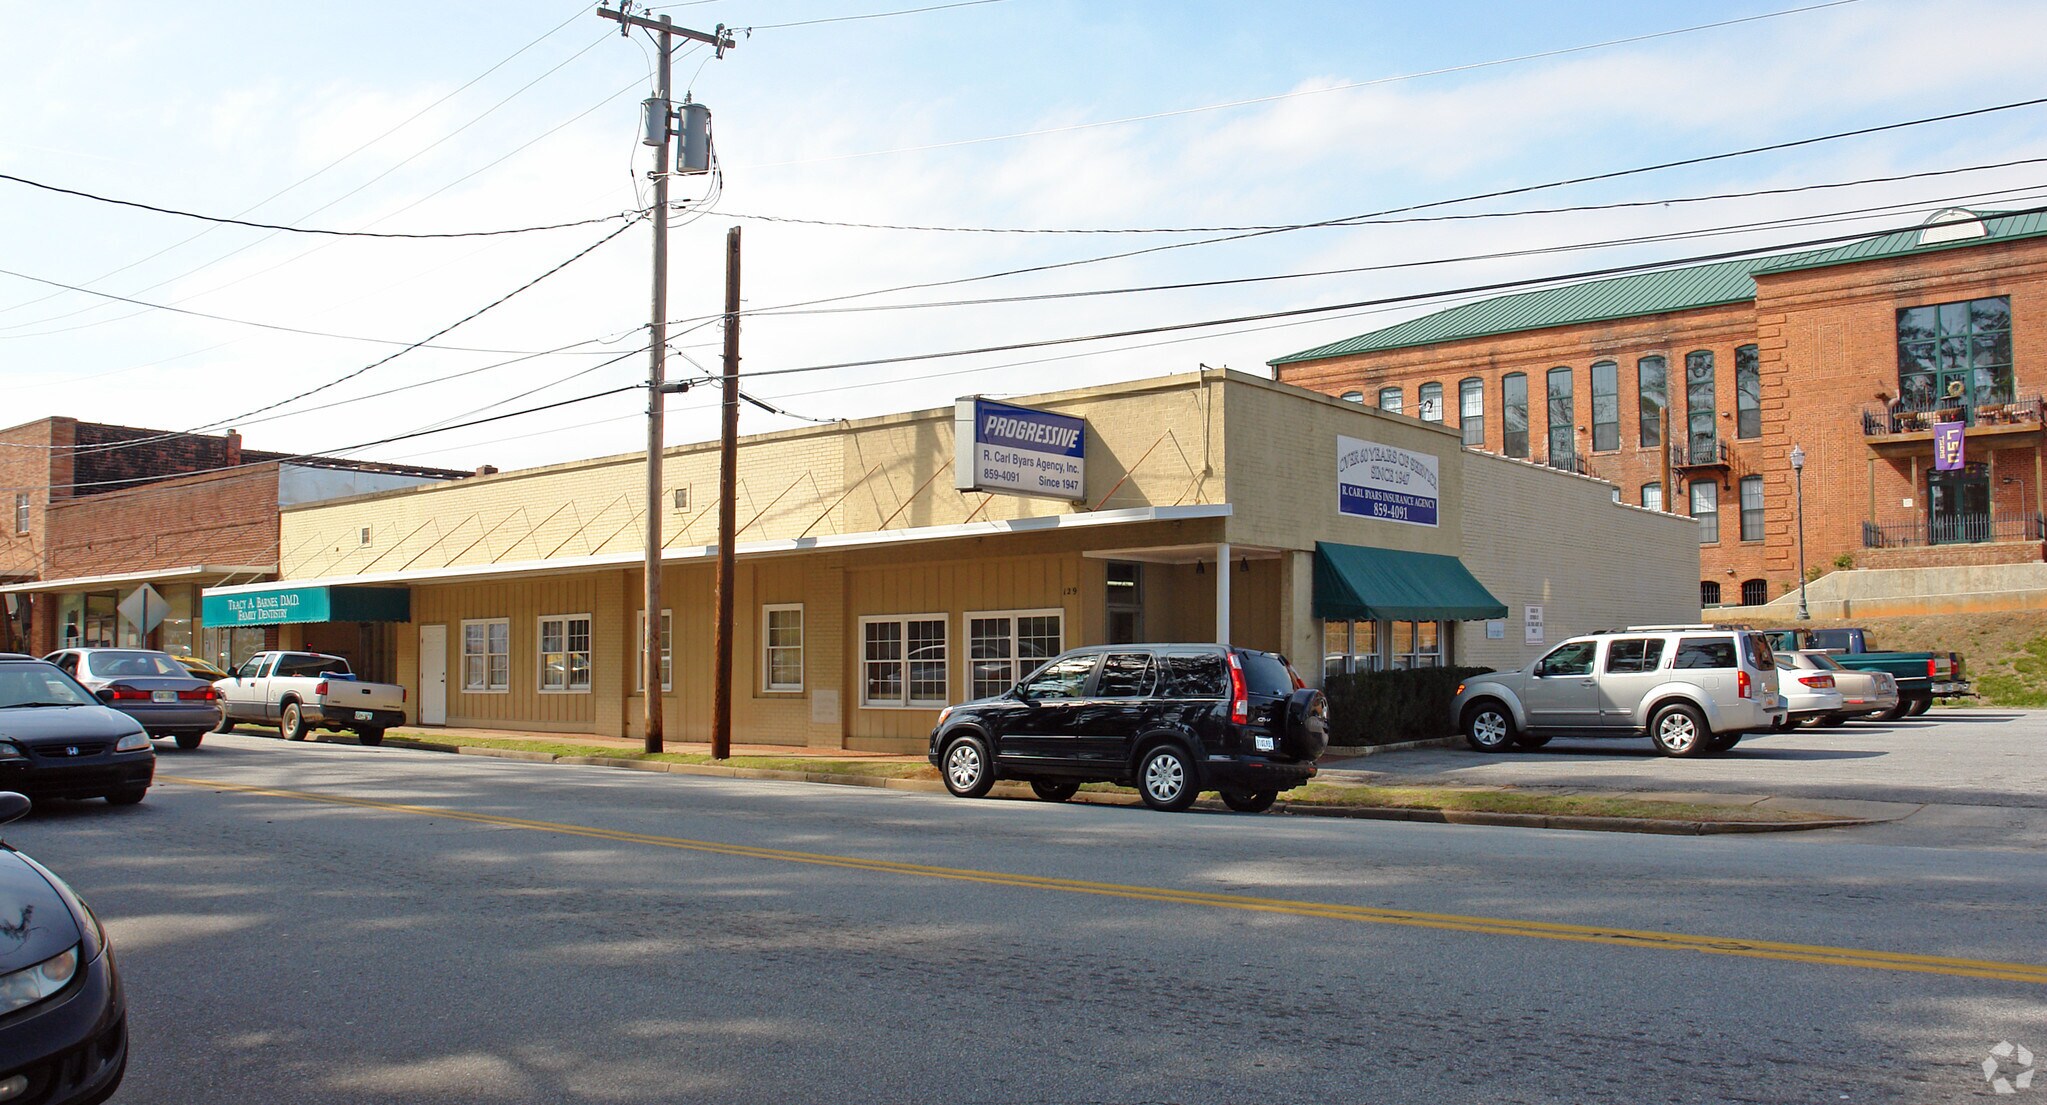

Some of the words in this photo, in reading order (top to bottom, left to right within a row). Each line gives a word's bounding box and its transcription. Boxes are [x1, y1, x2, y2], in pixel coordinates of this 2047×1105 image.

[984, 415, 1080, 449] PROGRESSIVE
[1946, 429, 1960, 464] LSU
[983, 449, 992, 461] R.
[994, 451, 1011, 464] Carl
[1012, 454, 1034, 470] Byars
[1036, 458, 1065, 474] Agency,
[1066, 461, 1079, 474] Inc.
[1339, 451, 1360, 473] OVER
[1368, 447, 1397, 464] YEARS
[1398, 452, 1410, 468] OF
[1410, 457, 1438, 490] SERVICE
[984, 468, 1020, 483] 859-4091
[1038, 475, 1060, 488] Since
[1062, 479, 1079, 490] 1947
[1370, 465, 1394, 483] SINCE
[1395, 470, 1411, 485] 1947
[1342, 486, 1348, 495] R.
[1349, 486, 1364, 498] CARL
[1365, 489, 1383, 502] BYARS
[1383, 492, 1414, 506] INSURANCE
[1414, 497, 1435, 509] AGENCY
[1373, 502, 1408, 520] 859-4091
[247, 598, 255, 608] A.
[280, 594, 300, 606] D.M.D.
[1063, 587, 1077, 595] 129
